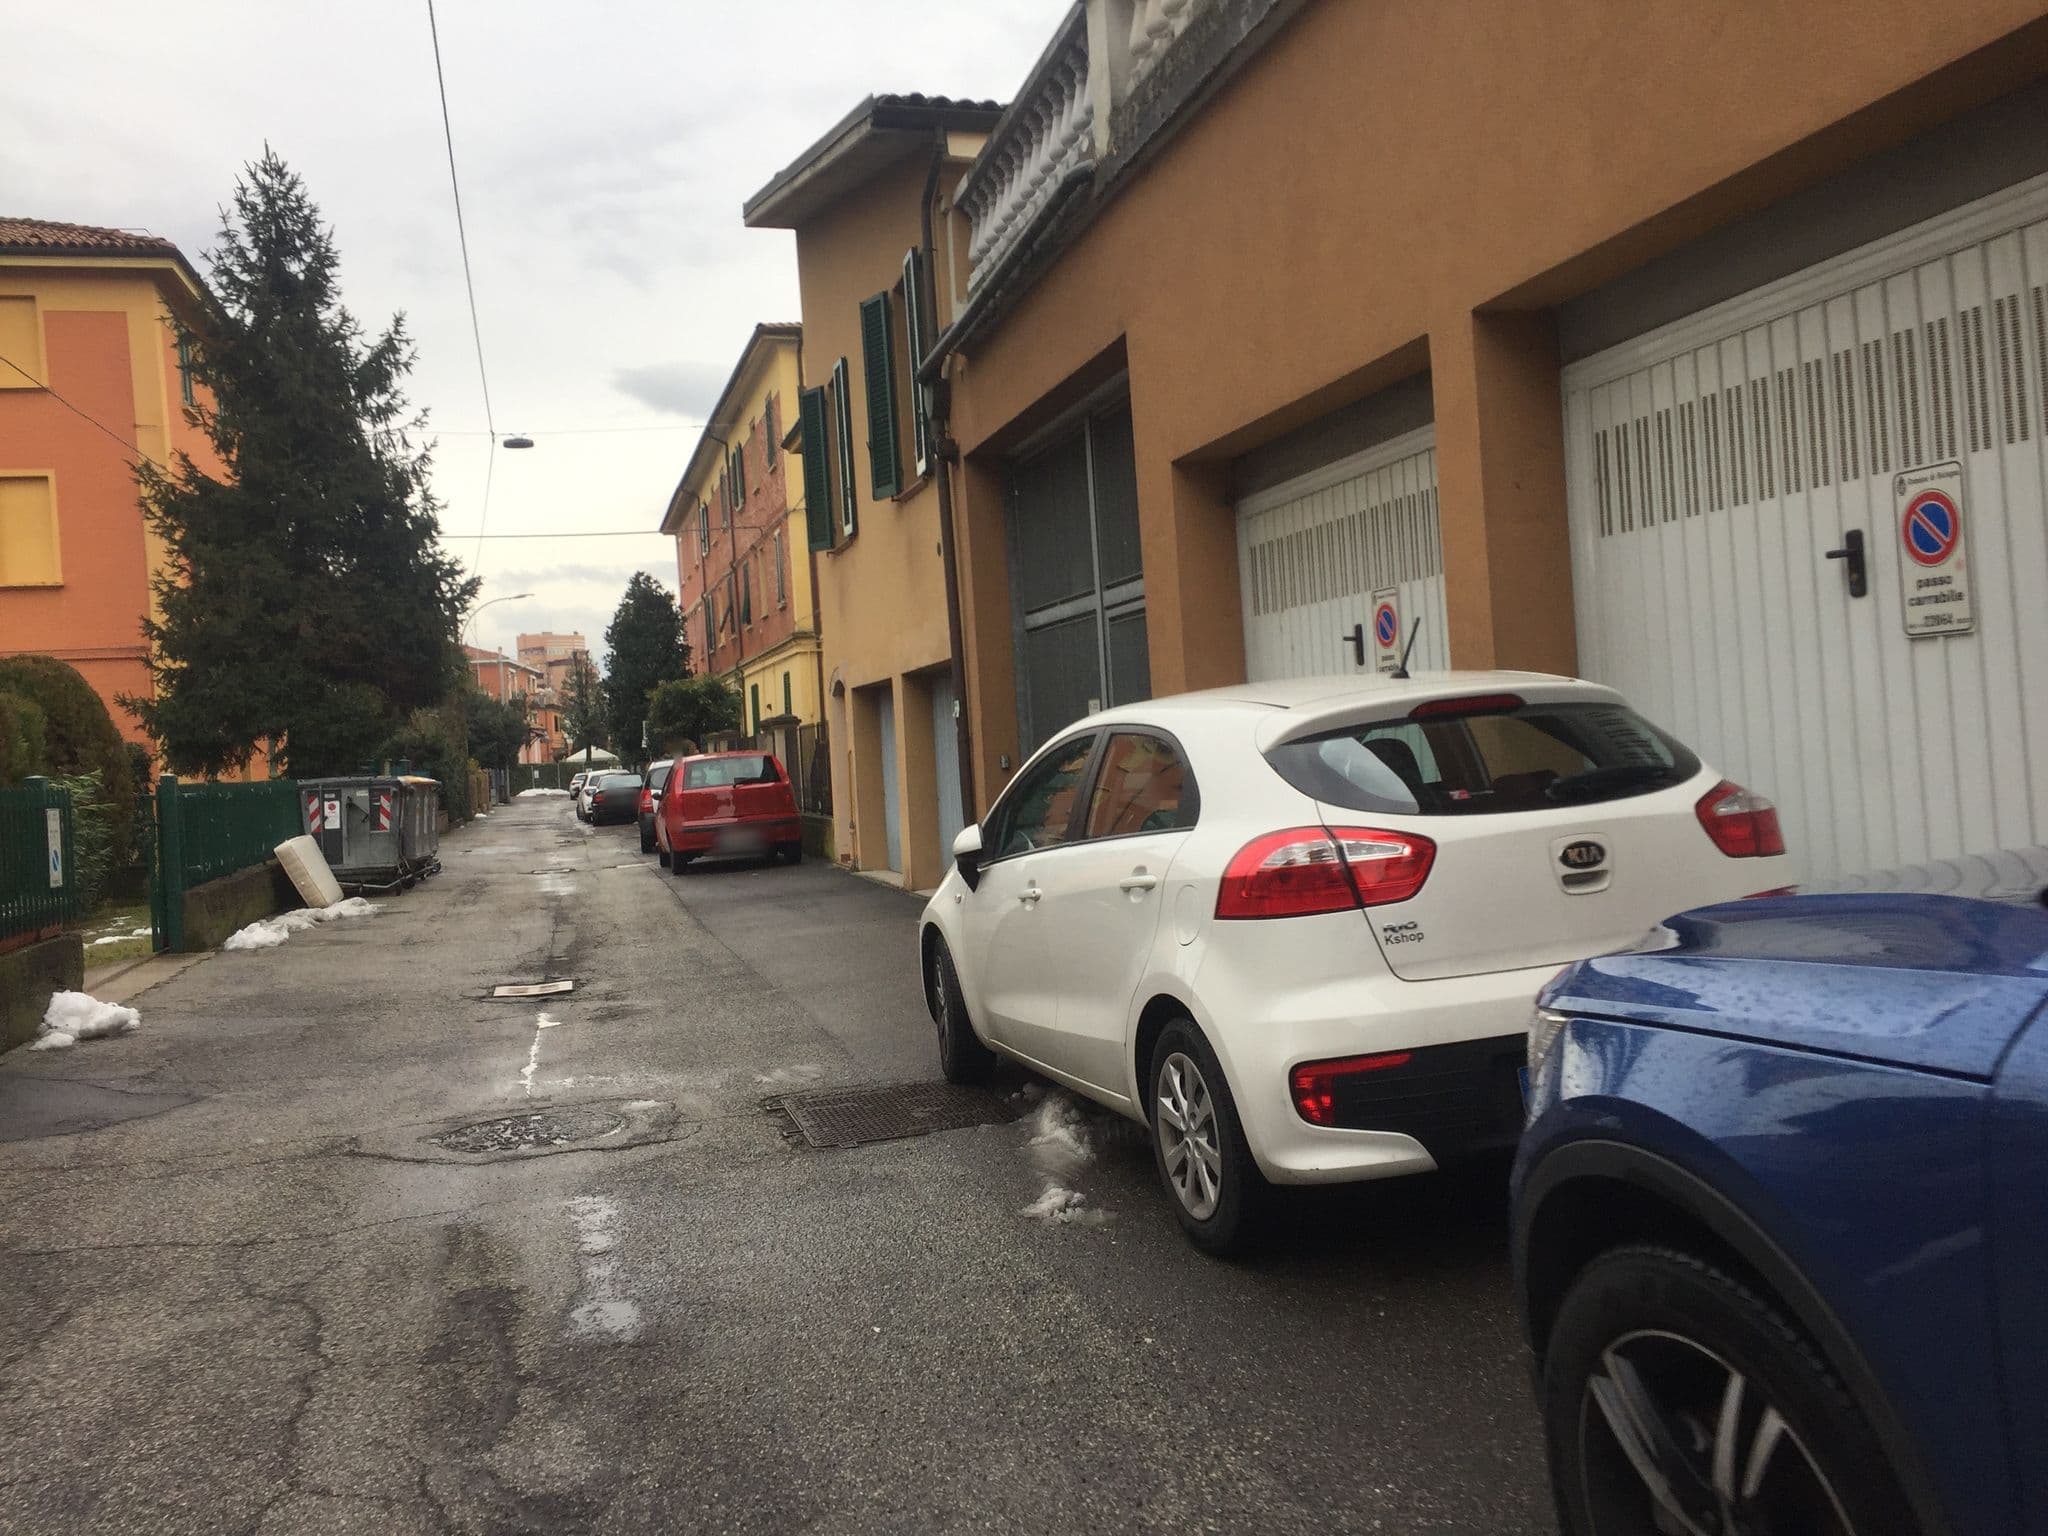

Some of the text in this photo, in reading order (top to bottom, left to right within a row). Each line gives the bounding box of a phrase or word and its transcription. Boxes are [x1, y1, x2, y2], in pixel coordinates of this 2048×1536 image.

[1916, 575, 1953, 591] passo
[1908, 589, 1965, 607] carrabile
[1566, 845, 1602, 863] KIA
[1384, 930, 1425, 945] Kshop
